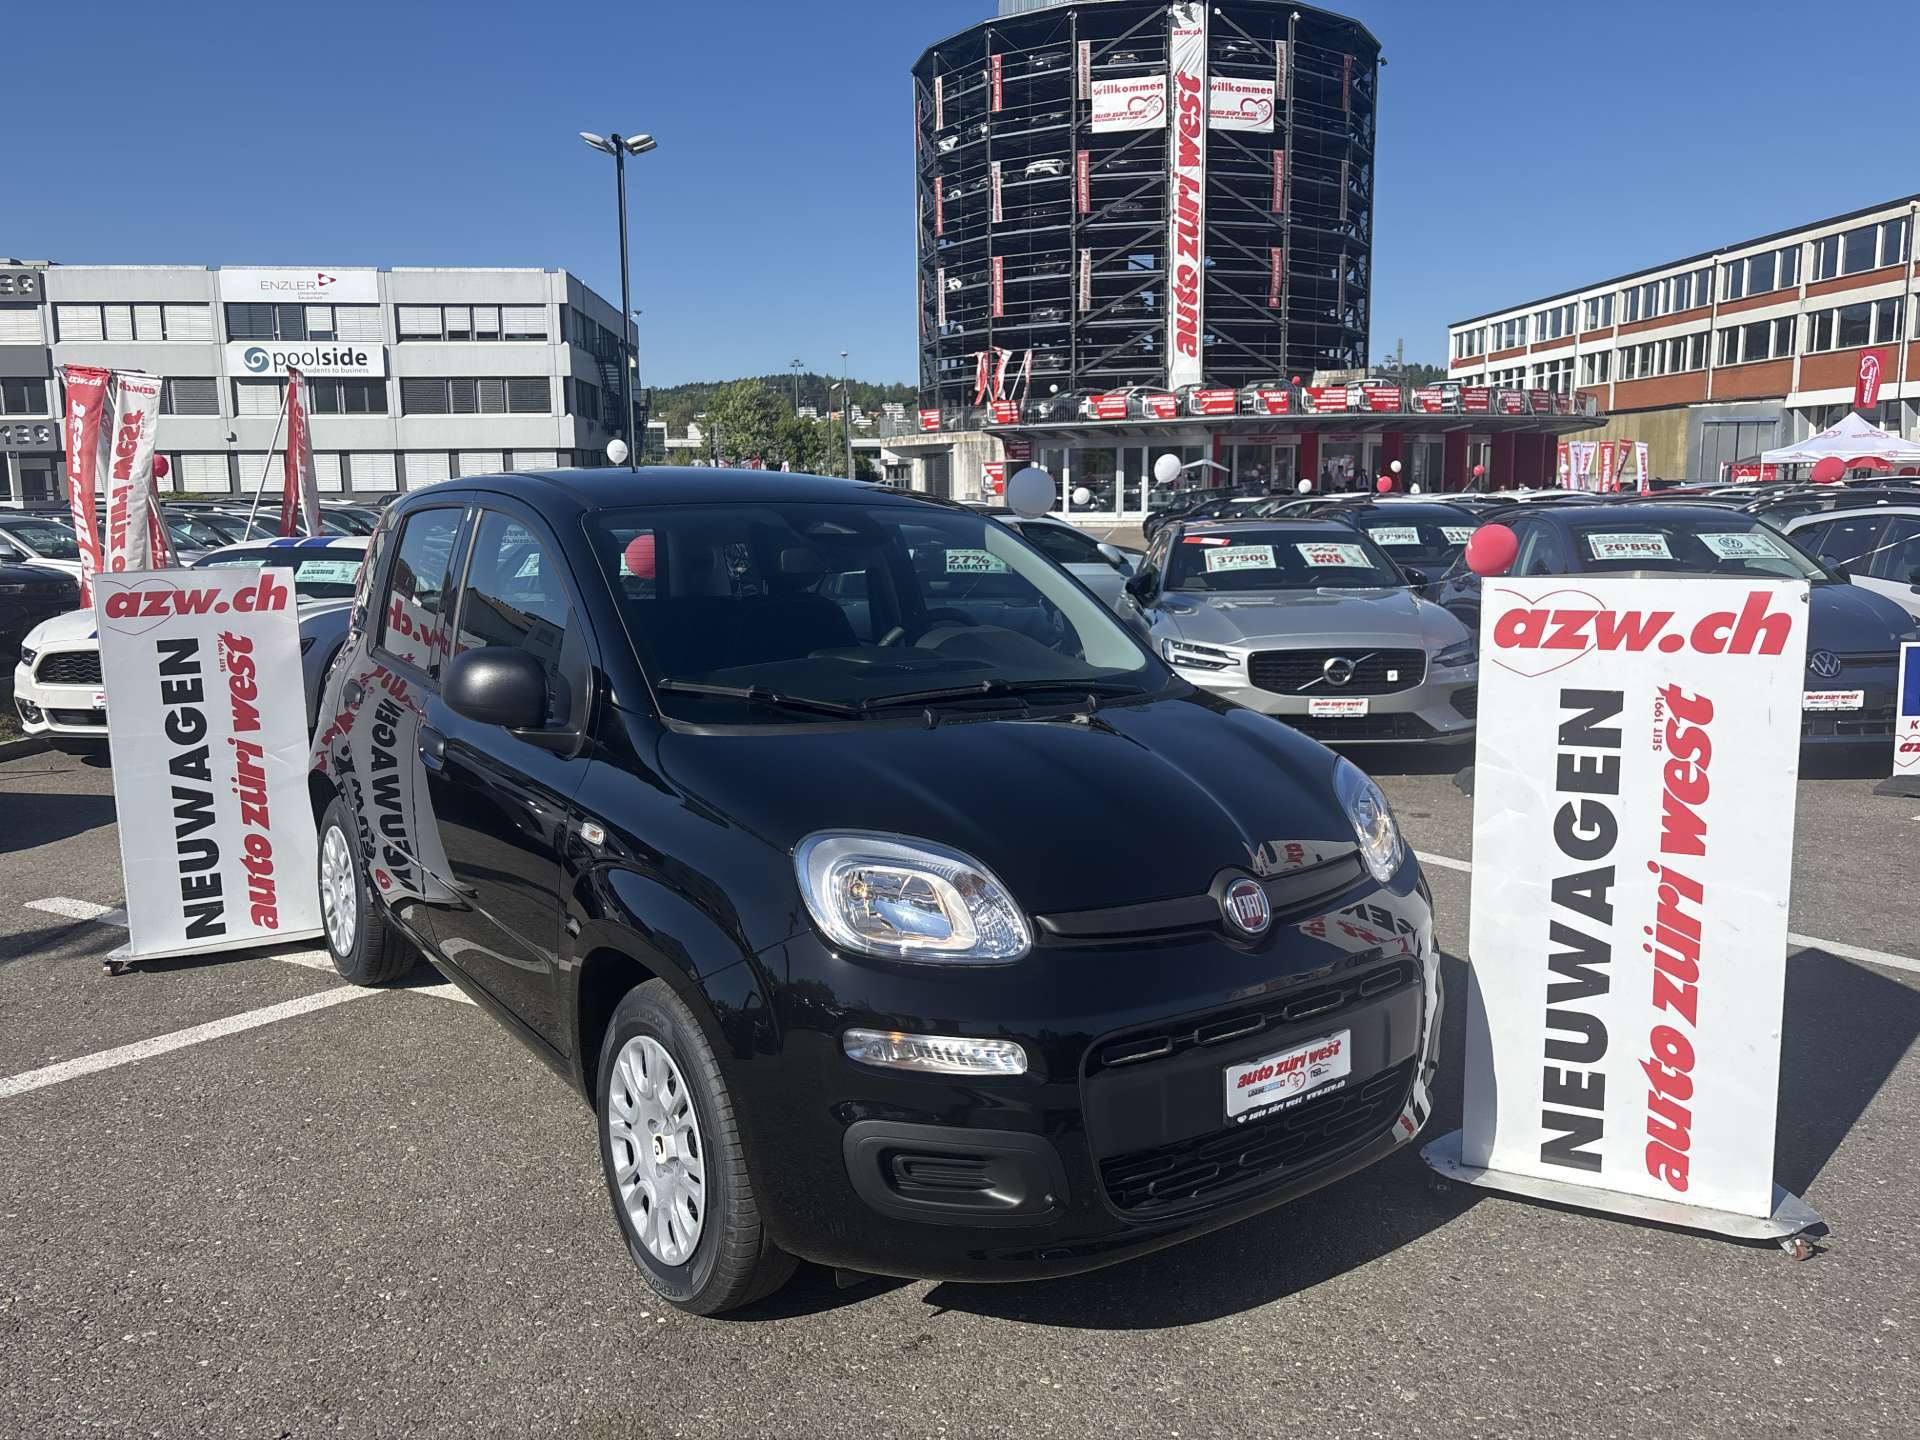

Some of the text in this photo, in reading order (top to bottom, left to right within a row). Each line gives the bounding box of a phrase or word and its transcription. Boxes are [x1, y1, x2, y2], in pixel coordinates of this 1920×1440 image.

[1173, 28, 1203, 36] azw.ch
[1093, 82, 1164, 96] willkommen
[1210, 82, 1273, 95] willkommen
[1173, 70, 1201, 358] auto züri west
[260, 280, 316, 290] ENZLER
[272, 347, 368, 373] poolside
[341, 366, 369, 375] business
[72, 399, 86, 474] west
[948, 555, 990, 564] 27%
[1216, 553, 1269, 564] 37'500
[1604, 543, 1662, 551] 26'850
[105, 573, 288, 619] azw.ch
[1492, 590, 1793, 656] azw.ch
[1652, 696, 1665, 752] SEIT 1991
[156, 637, 227, 941] NEUWAGEN
[217, 631, 279, 930] auto züri west
[1236, 893, 1265, 921] FIAT
[1539, 687, 1625, 1174] NEUWAGEN
[1637, 682, 1714, 1193] auto züri west
[1237, 1064, 1274, 1089] auto
[1275, 1050, 1308, 1077] züri
[1309, 1039, 1342, 1063] west
[1248, 1080, 1346, 1121] auto züri west www.azw.ch
